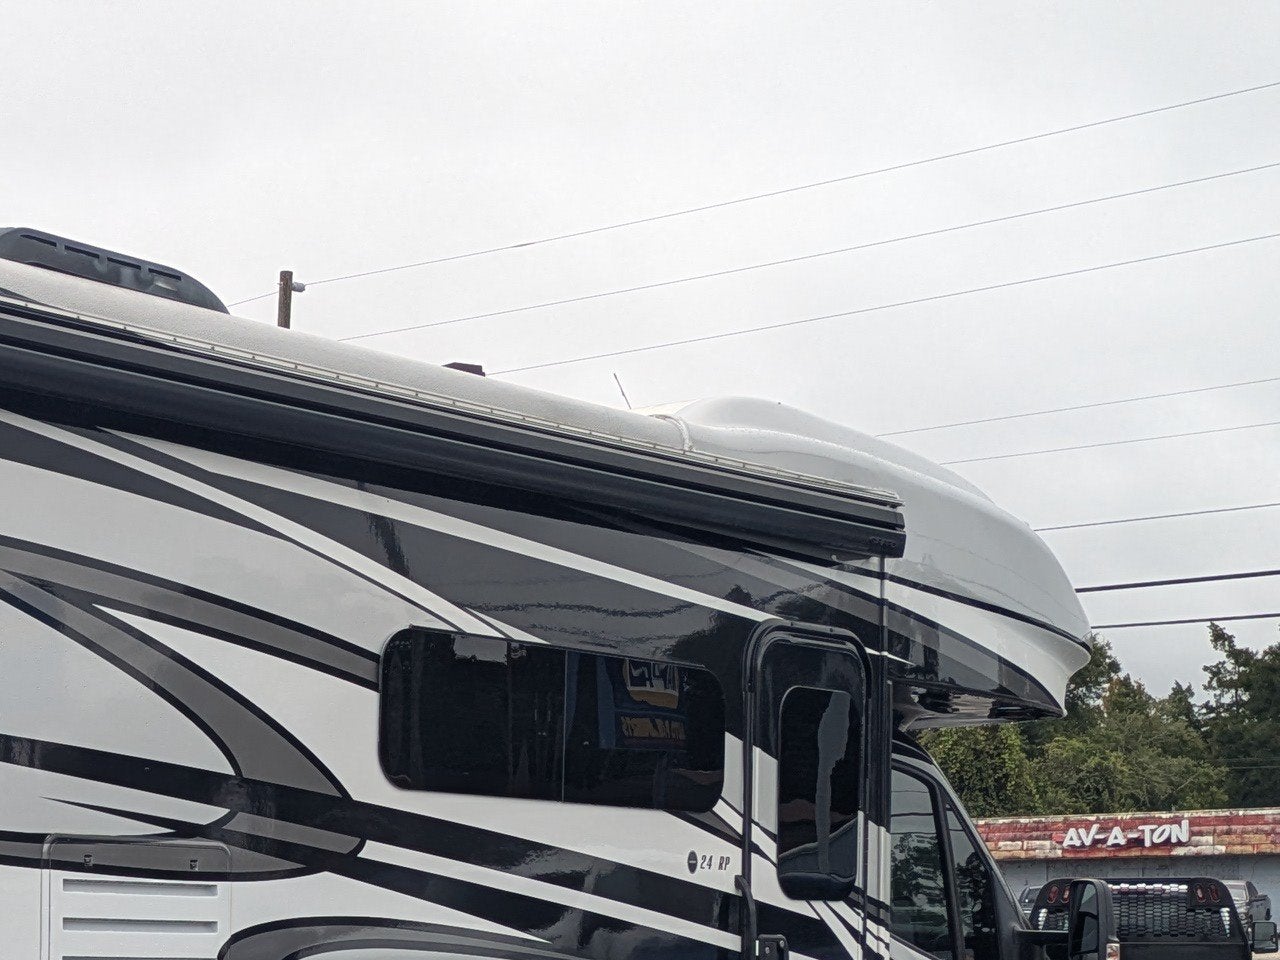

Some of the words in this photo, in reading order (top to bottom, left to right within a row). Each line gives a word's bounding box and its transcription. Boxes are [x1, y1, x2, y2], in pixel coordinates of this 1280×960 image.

[1062, 819, 1190, 848] AV-A-TON
[700, 854, 713, 870] 24
[718, 855, 731, 871] RP
